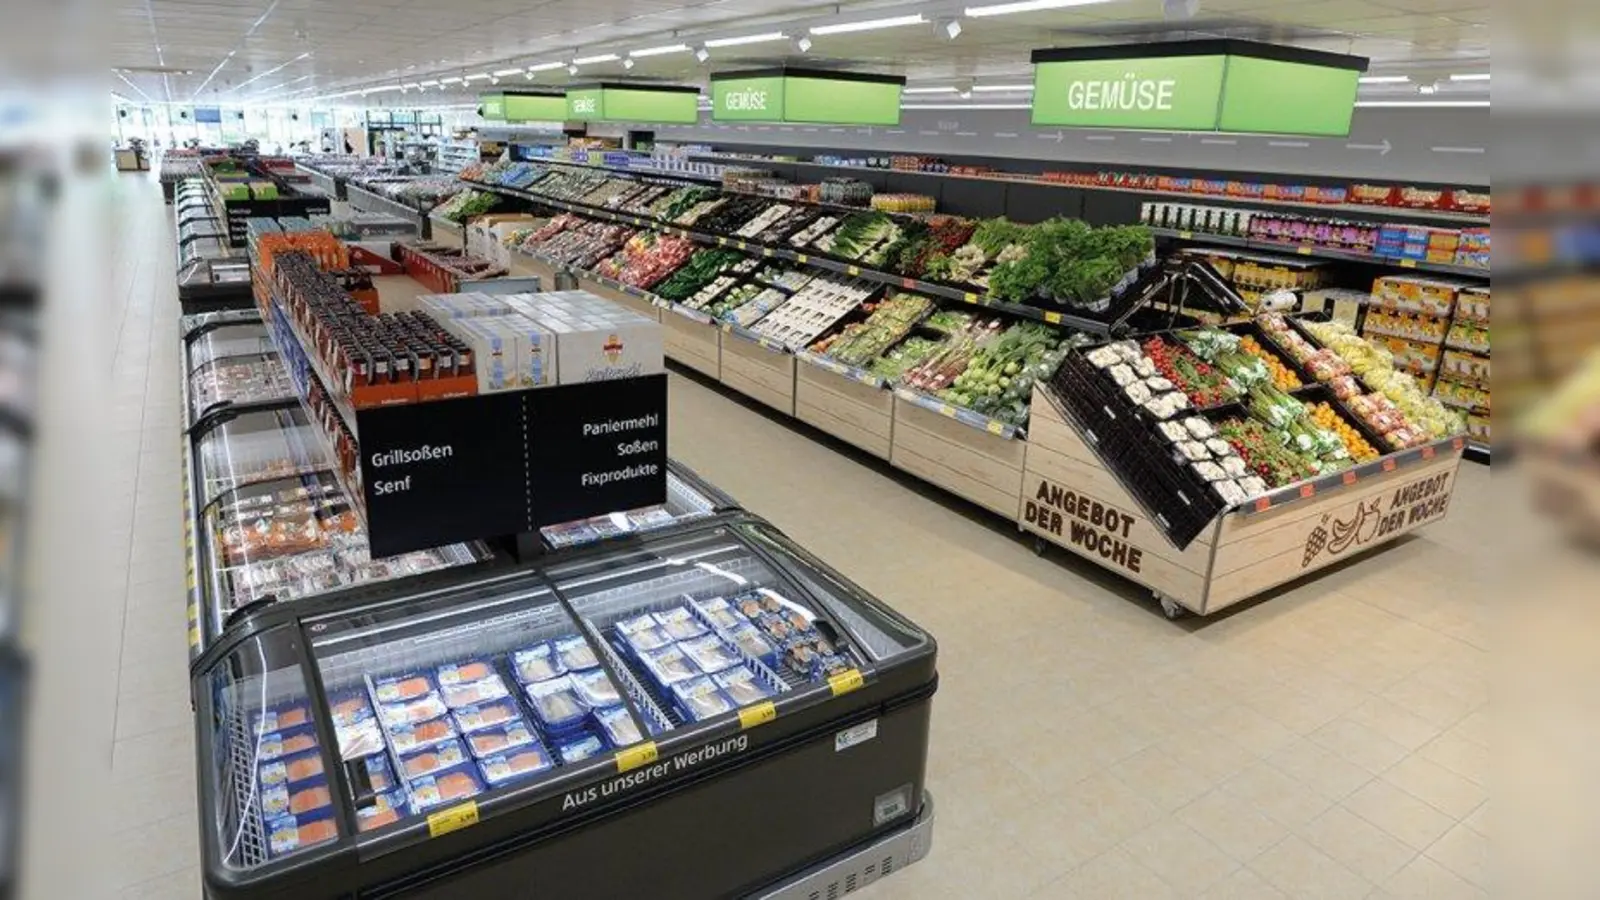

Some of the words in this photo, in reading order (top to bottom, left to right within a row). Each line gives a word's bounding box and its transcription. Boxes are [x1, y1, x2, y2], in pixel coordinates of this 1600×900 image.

[726, 87, 767, 110] GEMÜSE
[1068, 72, 1175, 111] GEMÜSE
[582, 413, 659, 436] Paniermehl
[371, 444, 453, 467] Grillsoßen
[617, 439, 658, 456] Soßen
[374, 475, 411, 496] Senf
[581, 464, 658, 486] Fixprodukte
[1390, 472, 1450, 510] ANGEBOT
[1036, 480, 1135, 538] ANGEBOT
[1377, 510, 1406, 537] DER
[1408, 492, 1449, 525] WOCHE
[1025, 501, 1063, 536] DER
[1070, 520, 1143, 573] WOCHE
[562, 787, 598, 811] Aus
[601, 761, 672, 796] unserer
[673, 734, 748, 770] Werbung
